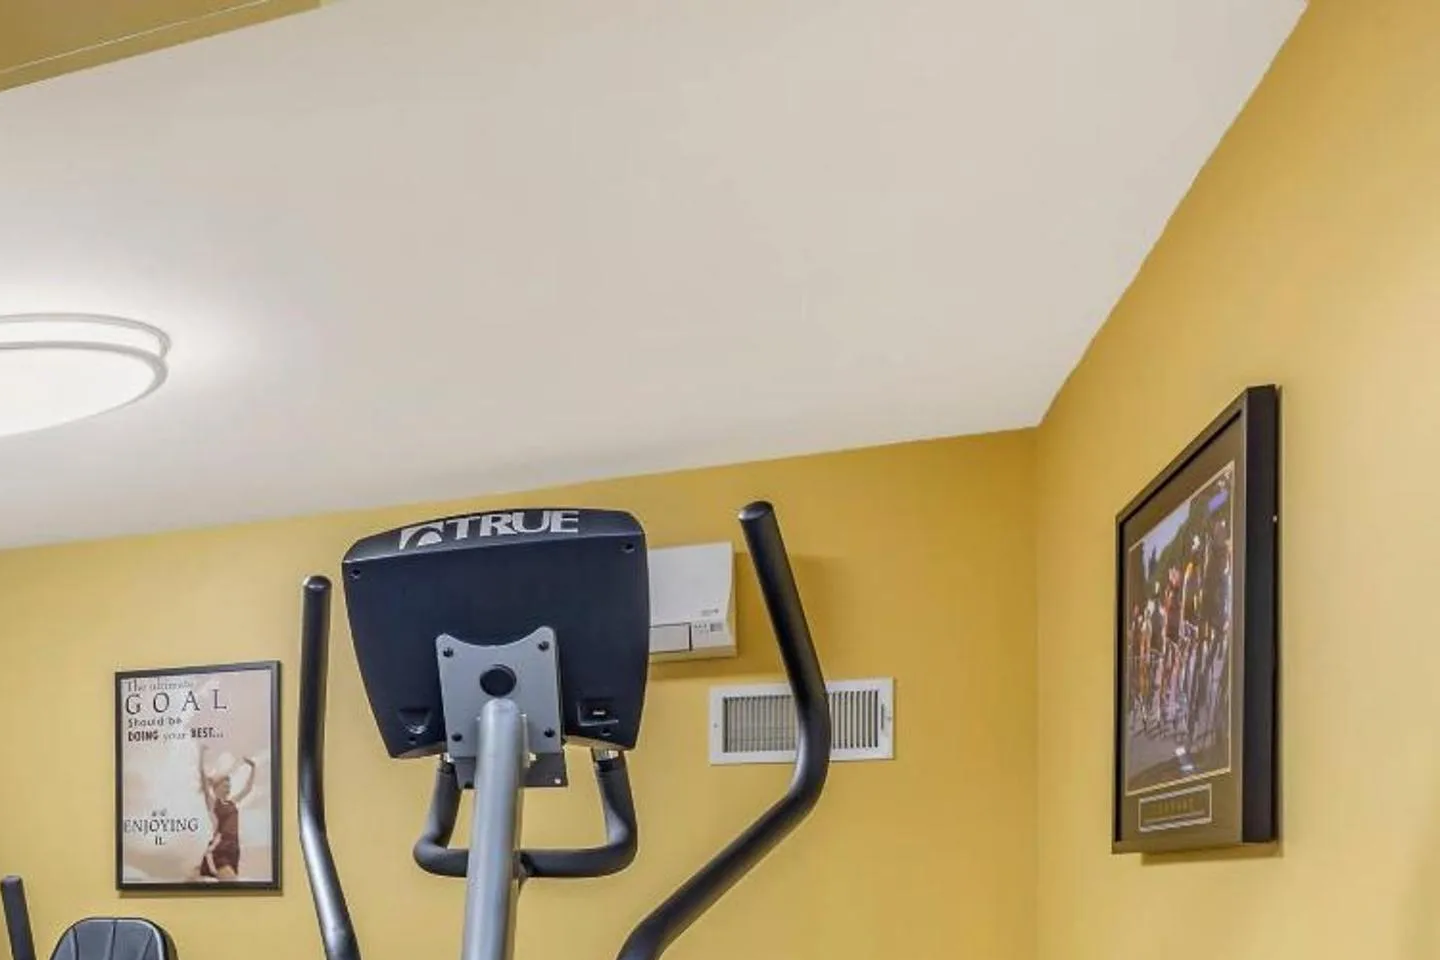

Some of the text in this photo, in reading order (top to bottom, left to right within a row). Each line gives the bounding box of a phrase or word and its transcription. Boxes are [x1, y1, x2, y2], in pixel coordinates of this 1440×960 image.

[444, 510, 579, 540] TRUE
[125, 688, 227, 715] GOAL
[128, 730, 159, 742] DOING
[124, 817, 199, 835] ENJOYING
